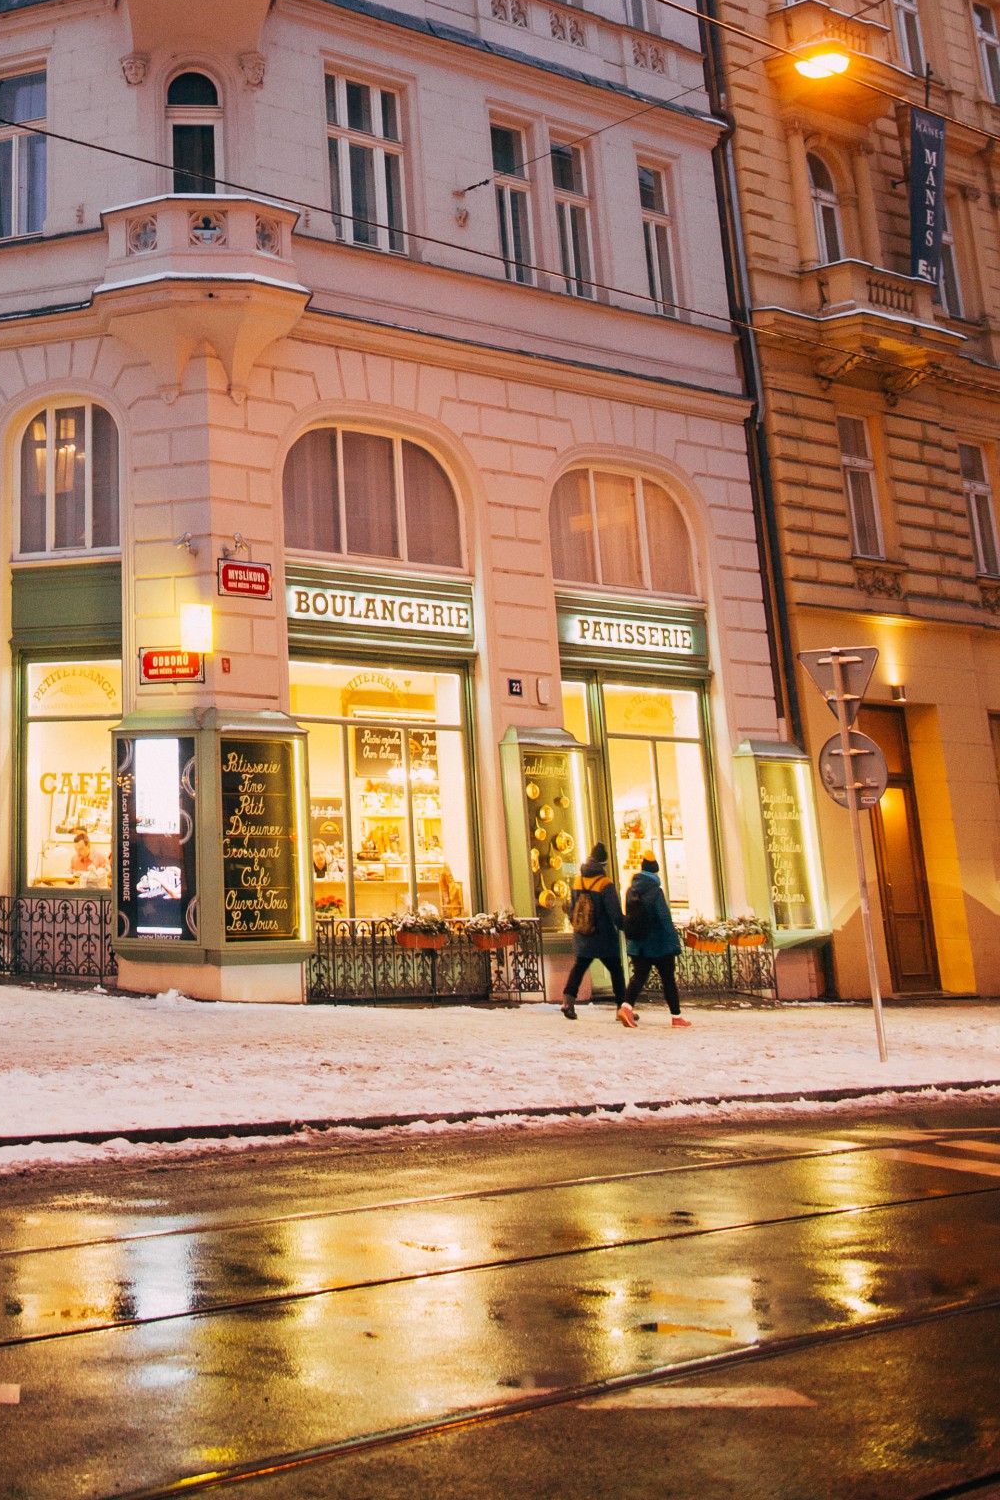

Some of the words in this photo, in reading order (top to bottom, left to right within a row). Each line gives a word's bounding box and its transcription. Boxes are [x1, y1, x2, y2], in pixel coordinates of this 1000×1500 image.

[228, 569, 266, 583] MYSLÍKOVA
[294, 590, 469, 629] BOULANGERIE
[577, 619, 692, 649] PATISSERIE
[152, 652, 189, 667] ODBORŮ
[512, 682, 520, 692] 22
[40, 766, 111, 794] CAFÉ
[238, 773, 266, 793] Fine
[235, 795, 266, 815] Petit
[763, 807, 803, 820] roissants
[122, 813, 130, 840] MUSIC
[226, 815, 283, 845] Déjeuner
[122, 842, 130, 858] BAR
[223, 838, 282, 858] Croissant
[241, 866, 271, 895] Café
[226, 890, 265, 910] Ouvert
[264, 890, 288, 910] Tous
[226, 910, 248, 931] Les
[249, 910, 279, 930] Jours
